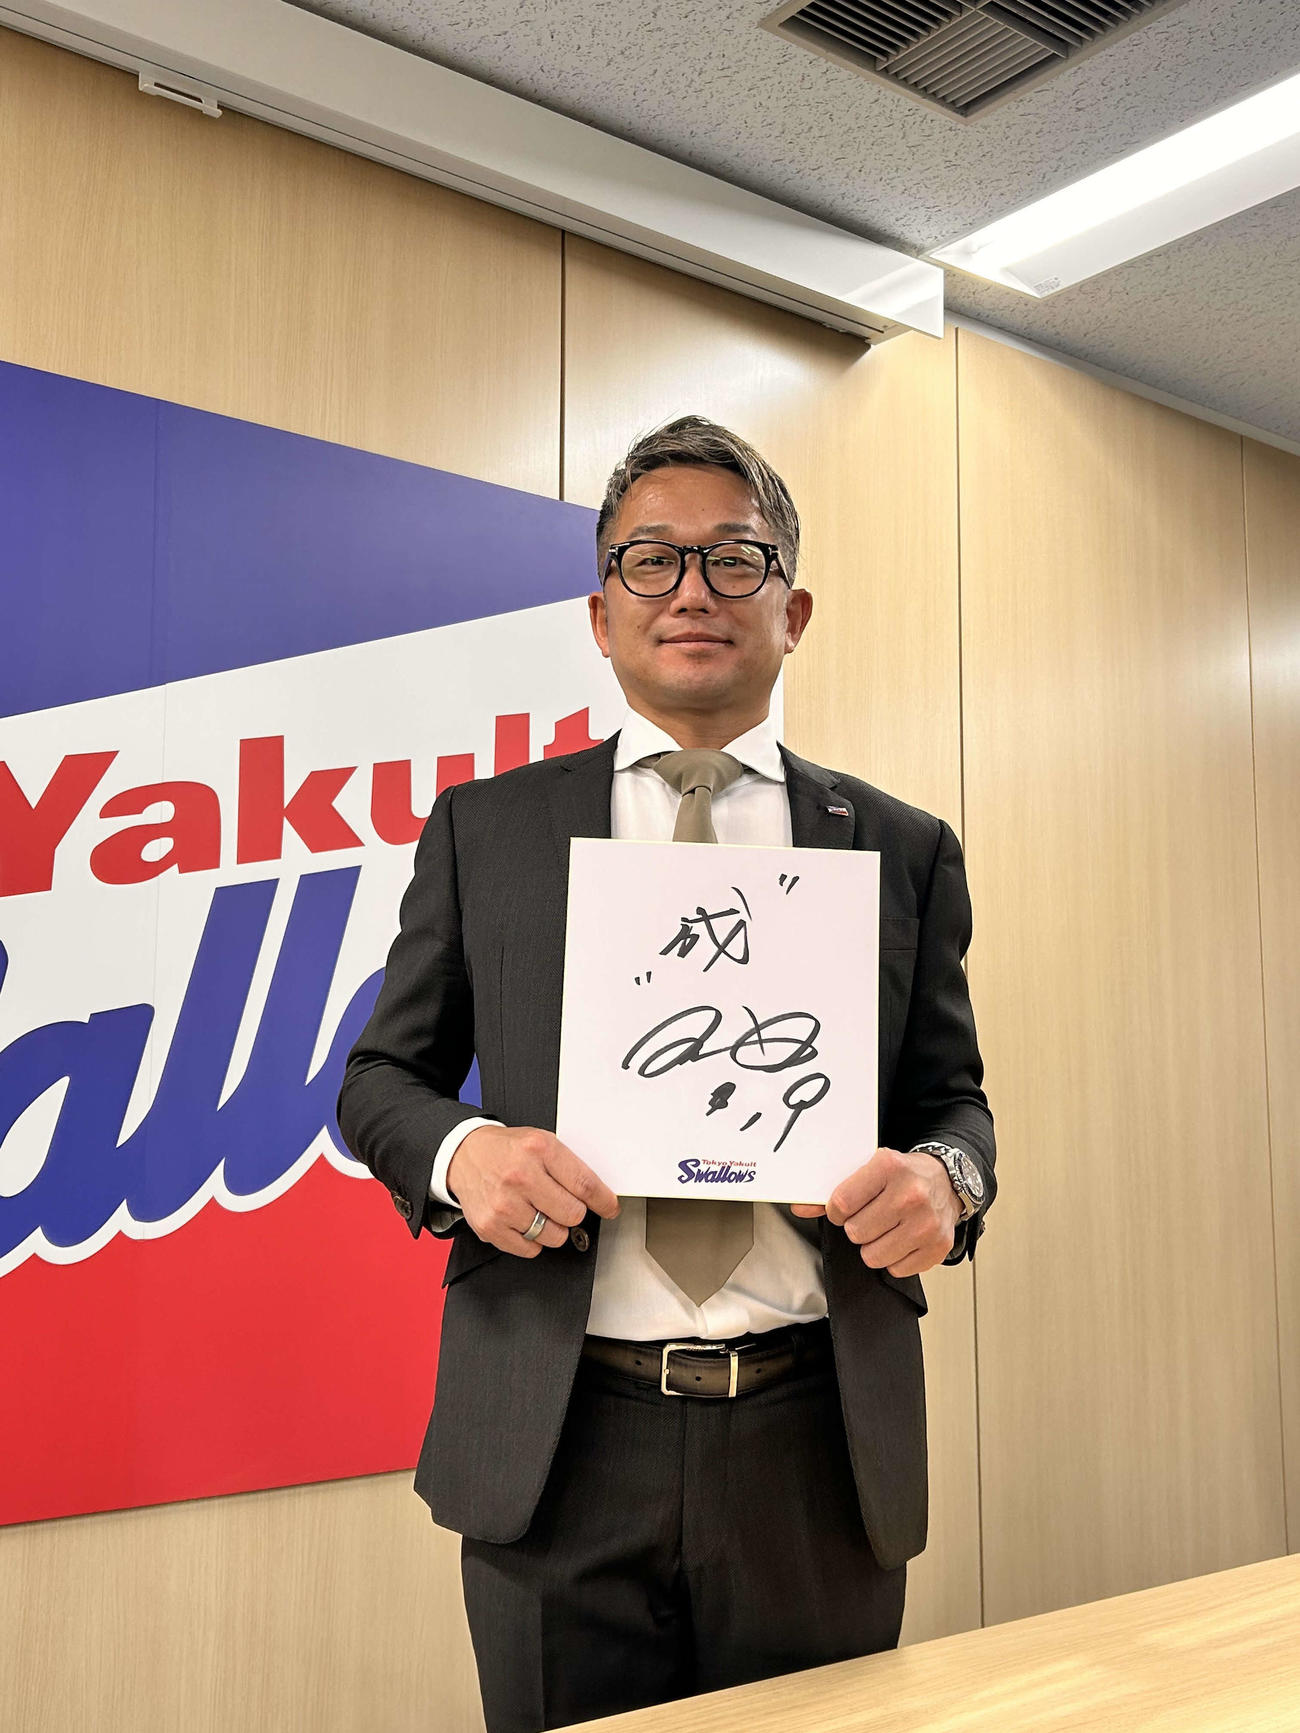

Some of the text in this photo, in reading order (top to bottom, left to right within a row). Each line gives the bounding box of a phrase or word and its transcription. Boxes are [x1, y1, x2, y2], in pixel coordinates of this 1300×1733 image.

[677, 1158, 757, 1184] Swallows
[701, 1159, 757, 1168] Tokyo Yakult
